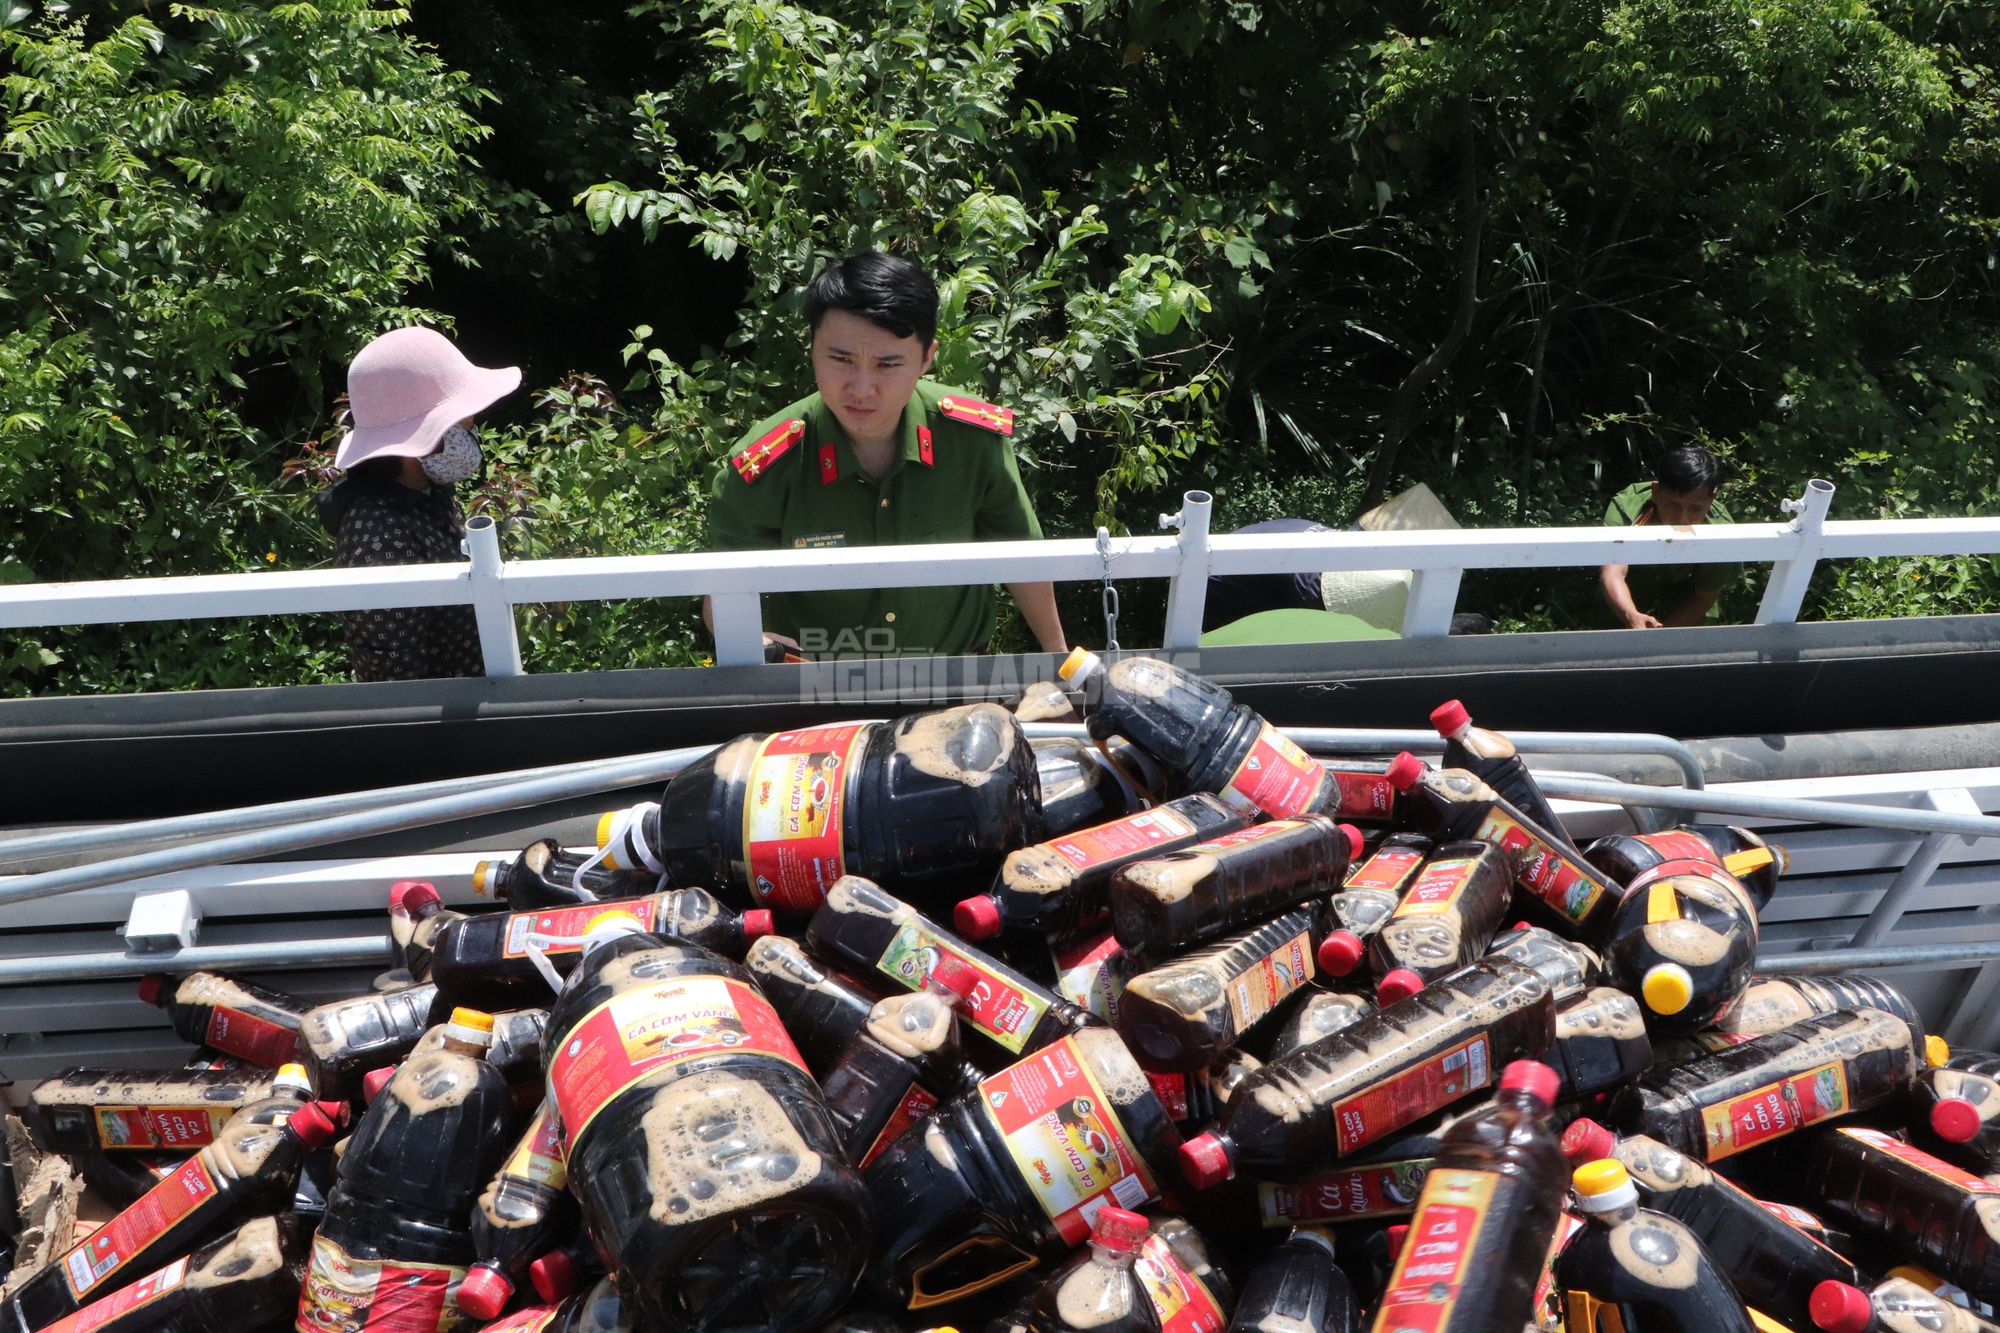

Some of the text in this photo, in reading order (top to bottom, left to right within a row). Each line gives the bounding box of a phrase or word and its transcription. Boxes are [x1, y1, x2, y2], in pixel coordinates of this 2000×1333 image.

[793, 756, 809, 783] VÀNG
[790, 786, 802, 814] CƠM
[789, 818, 799, 833] CÁ
[654, 987, 686, 999] Kapek
[967, 980, 991, 1012] Cá
[628, 1007, 734, 1040] CÁ CƠM VÀNG
[1007, 1006, 1027, 1031] Thanh
[1741, 1112, 1756, 1132] CÁ
[1767, 1094, 1787, 1130] VÀNG
[158, 1114, 177, 1143] VÀNG
[188, 1120, 202, 1136] CÁ
[1046, 1112, 1071, 1146] VÀNG
[1066, 1146, 1088, 1174] CƠM
[1081, 1174, 1096, 1188] CÁ
[1318, 1183, 1342, 1210] Cá
[316, 1285, 341, 1300] CƠM
